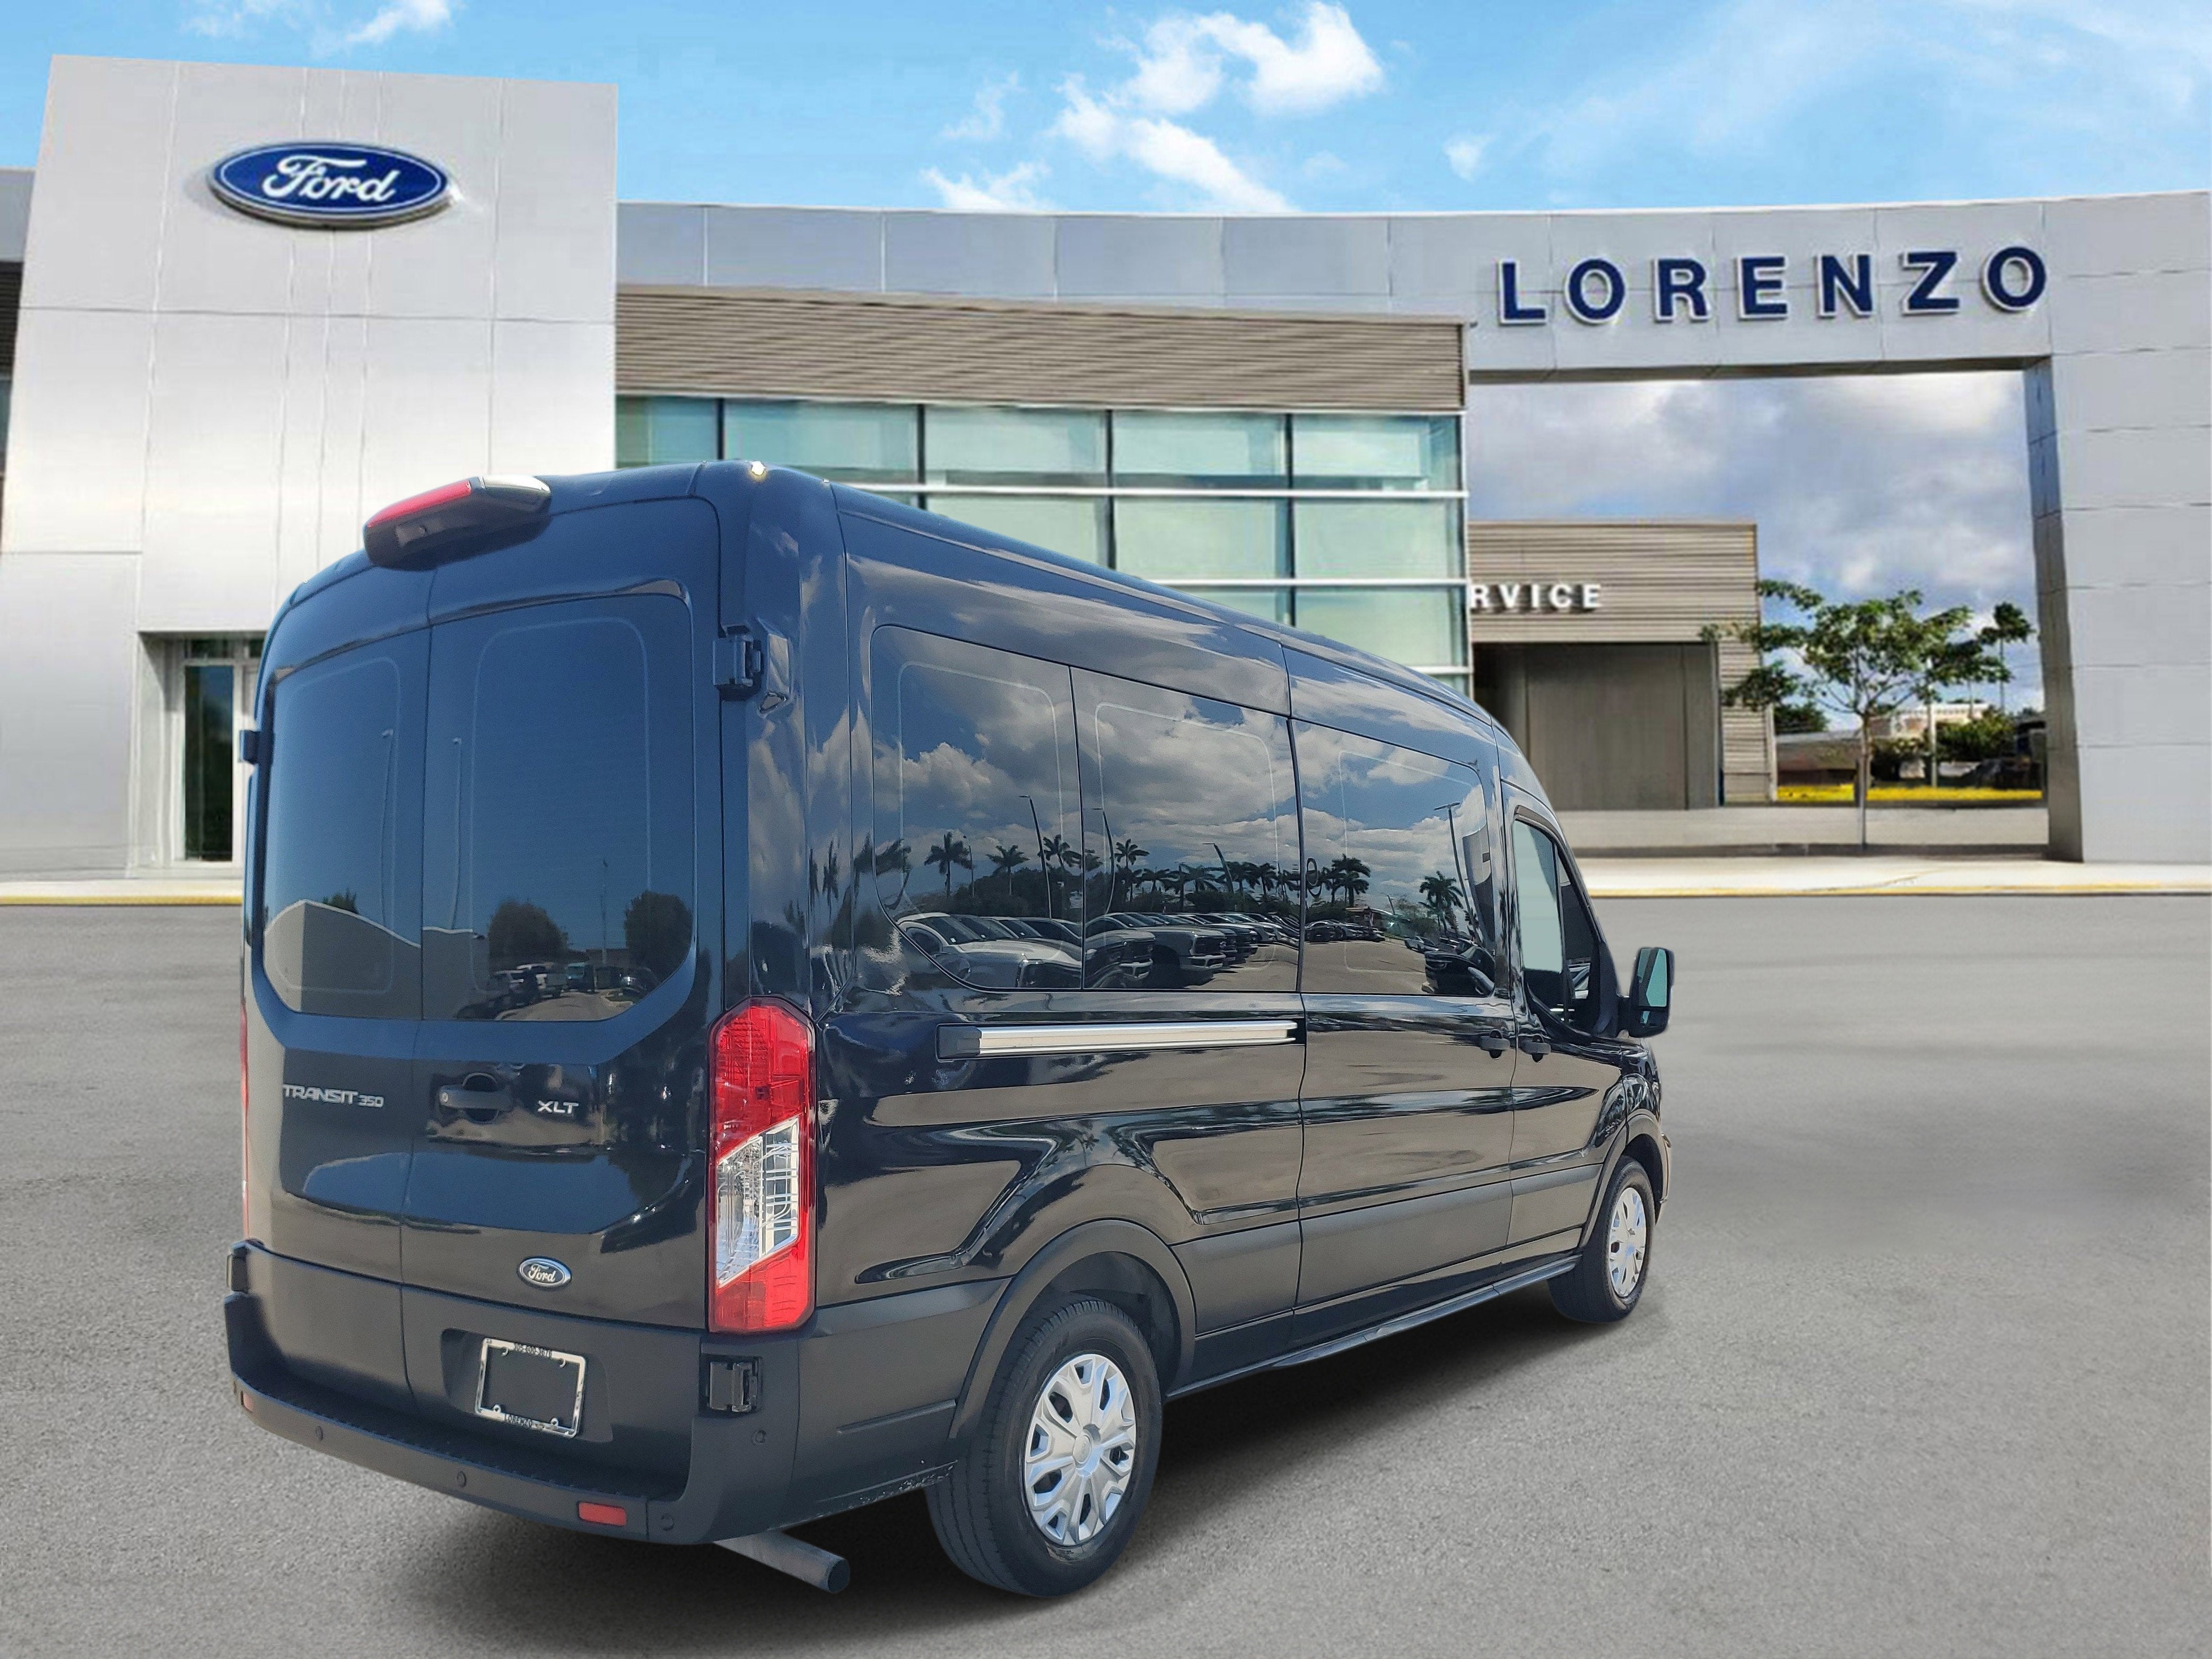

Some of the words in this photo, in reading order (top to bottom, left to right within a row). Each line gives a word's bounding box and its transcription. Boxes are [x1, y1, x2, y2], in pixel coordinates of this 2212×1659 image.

[262, 154, 400, 202] Ford
[1498, 246, 2047, 324] LORENZO
[282, 1084, 359, 1105] TRANSIT
[358, 1094, 384, 1108] 350
[537, 1099, 579, 1114] XLT
[528, 1263, 556, 1282] Ford
